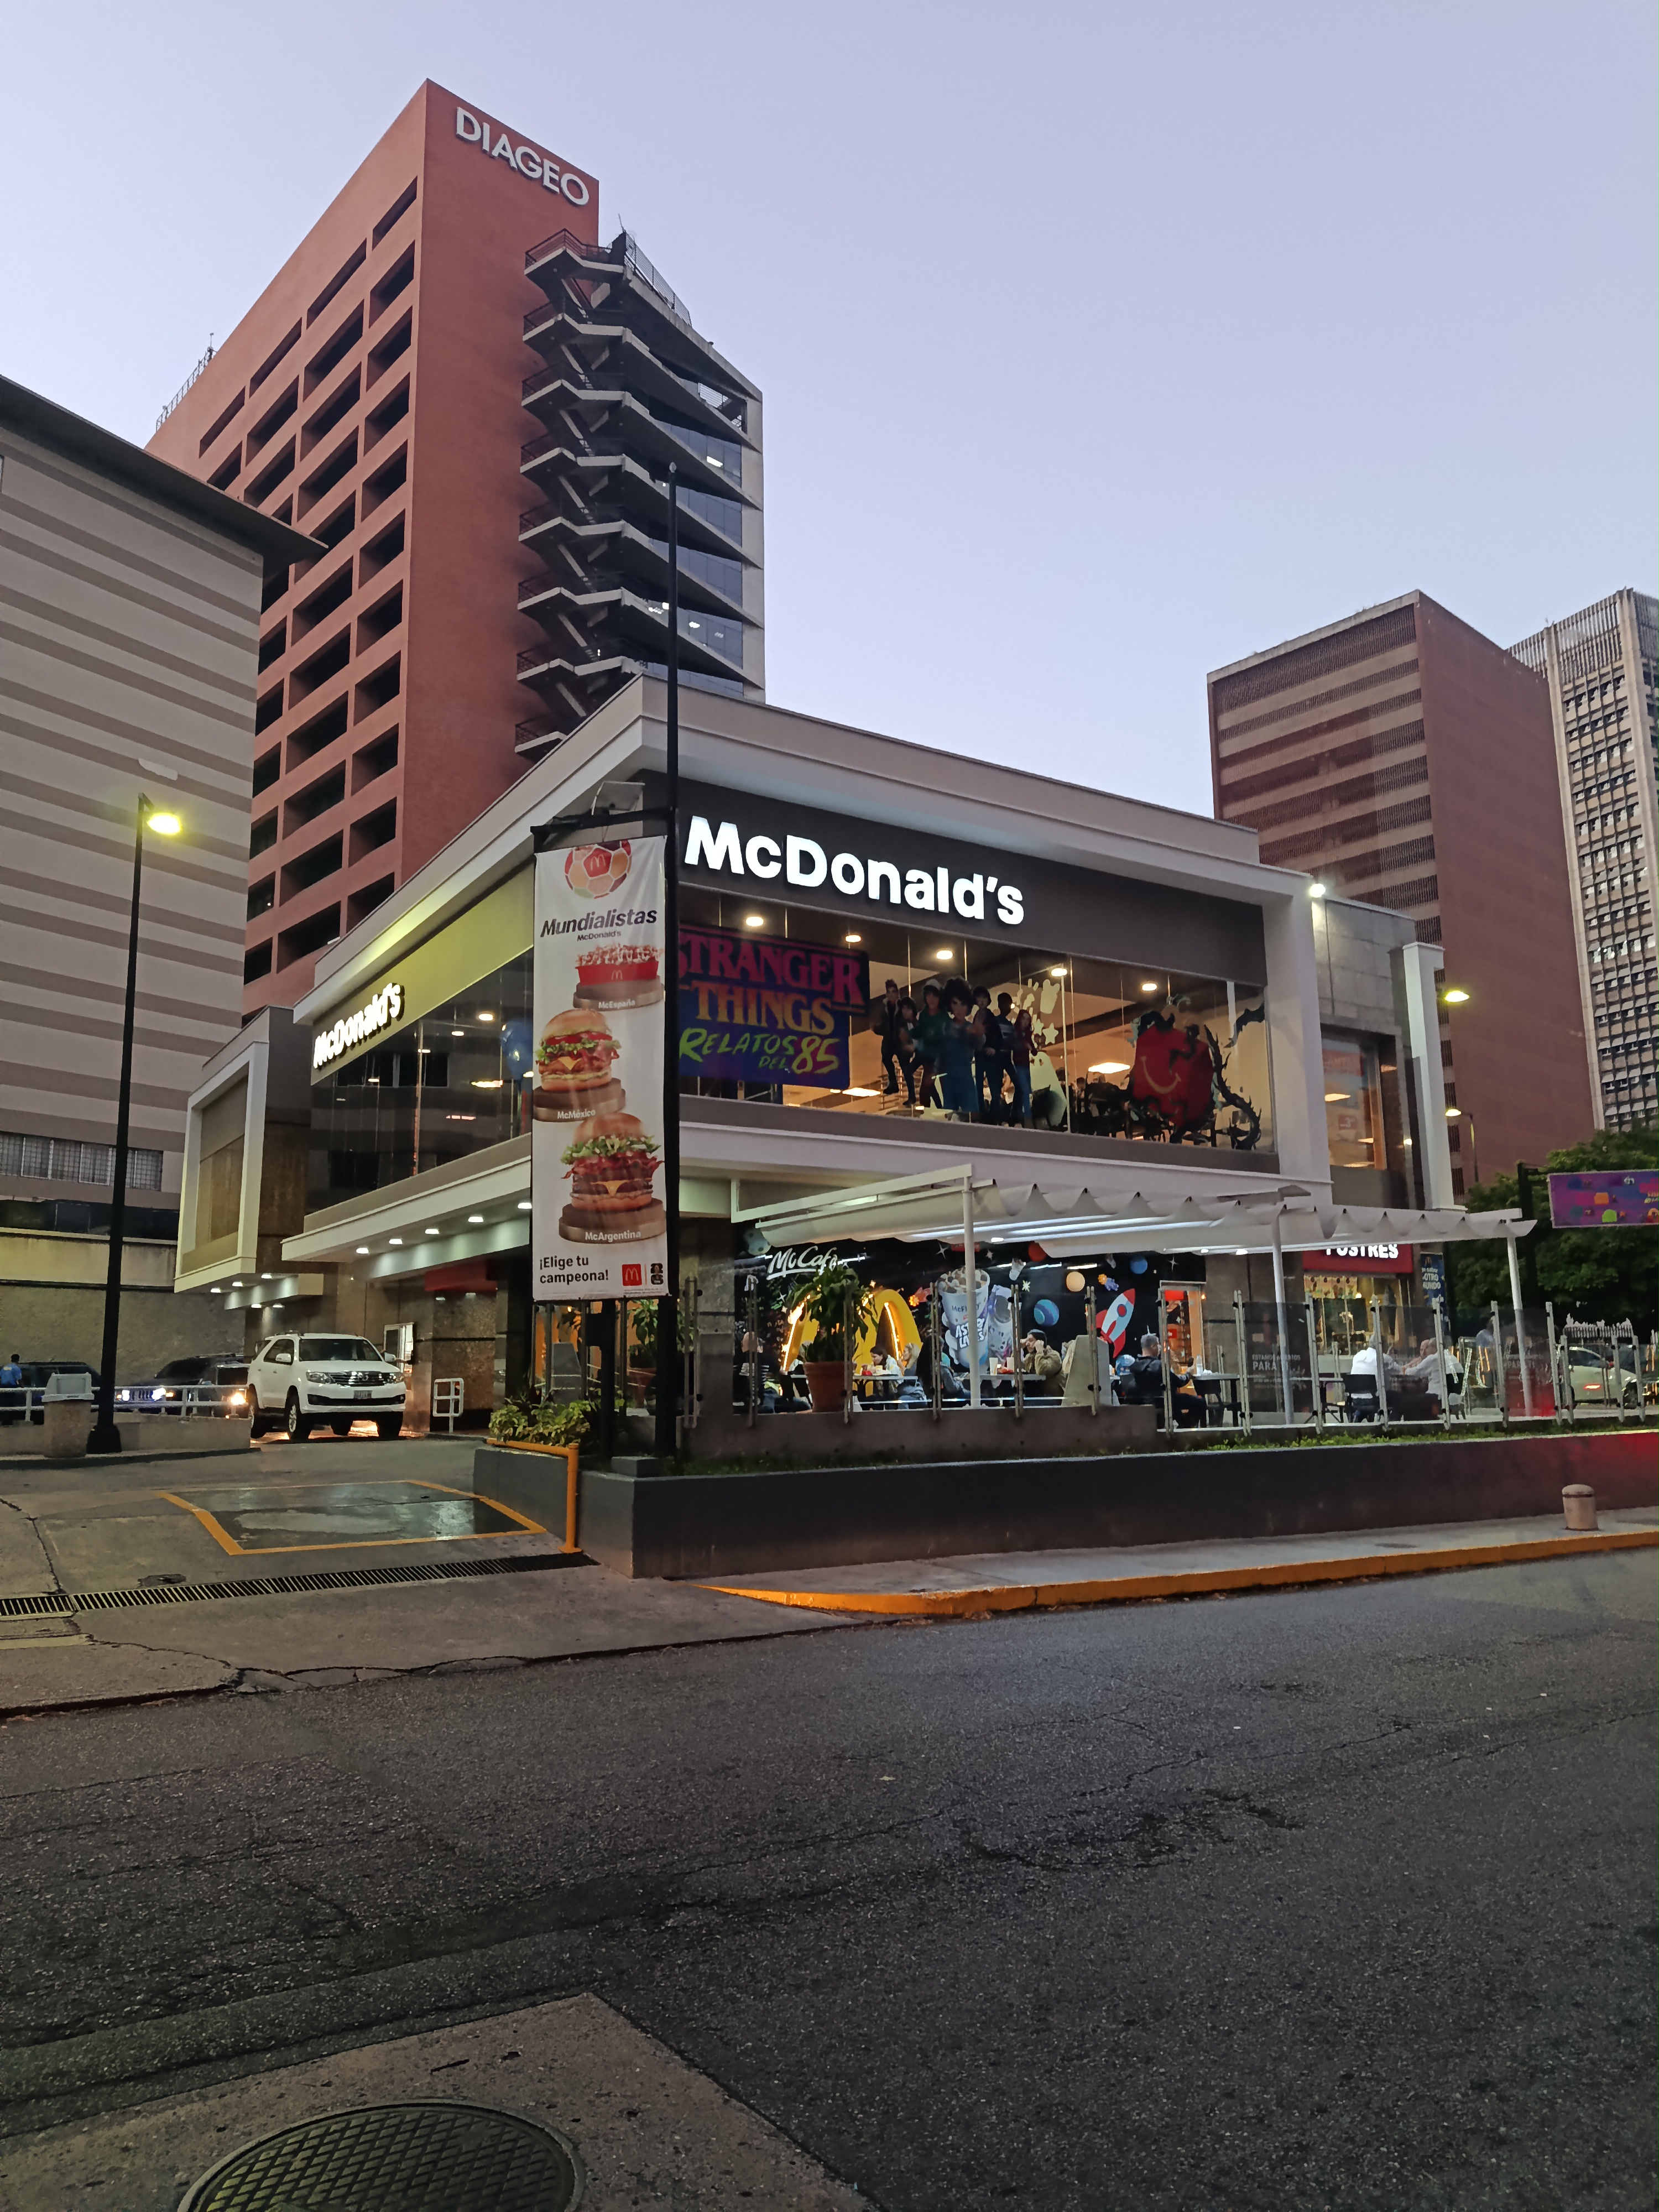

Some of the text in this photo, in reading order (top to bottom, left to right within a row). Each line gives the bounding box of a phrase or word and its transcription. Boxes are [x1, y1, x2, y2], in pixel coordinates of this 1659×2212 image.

[456, 107, 589, 206] DIAGEO
[684, 815, 1025, 925] McDonald's
[540, 909, 658, 937] Mundialistas
[577, 930, 622, 941] McDonald's
[691, 980, 834, 1036] THINGS
[313, 983, 402, 1068] McDonald's
[792, 1035, 841, 1074] 85
[585, 1230, 641, 1243] McArgentina
[540, 1255, 588, 1270] ¡Elige tu
[540, 1269, 608, 1285] campeona!
[1253, 1361, 1277, 1370] PARA
